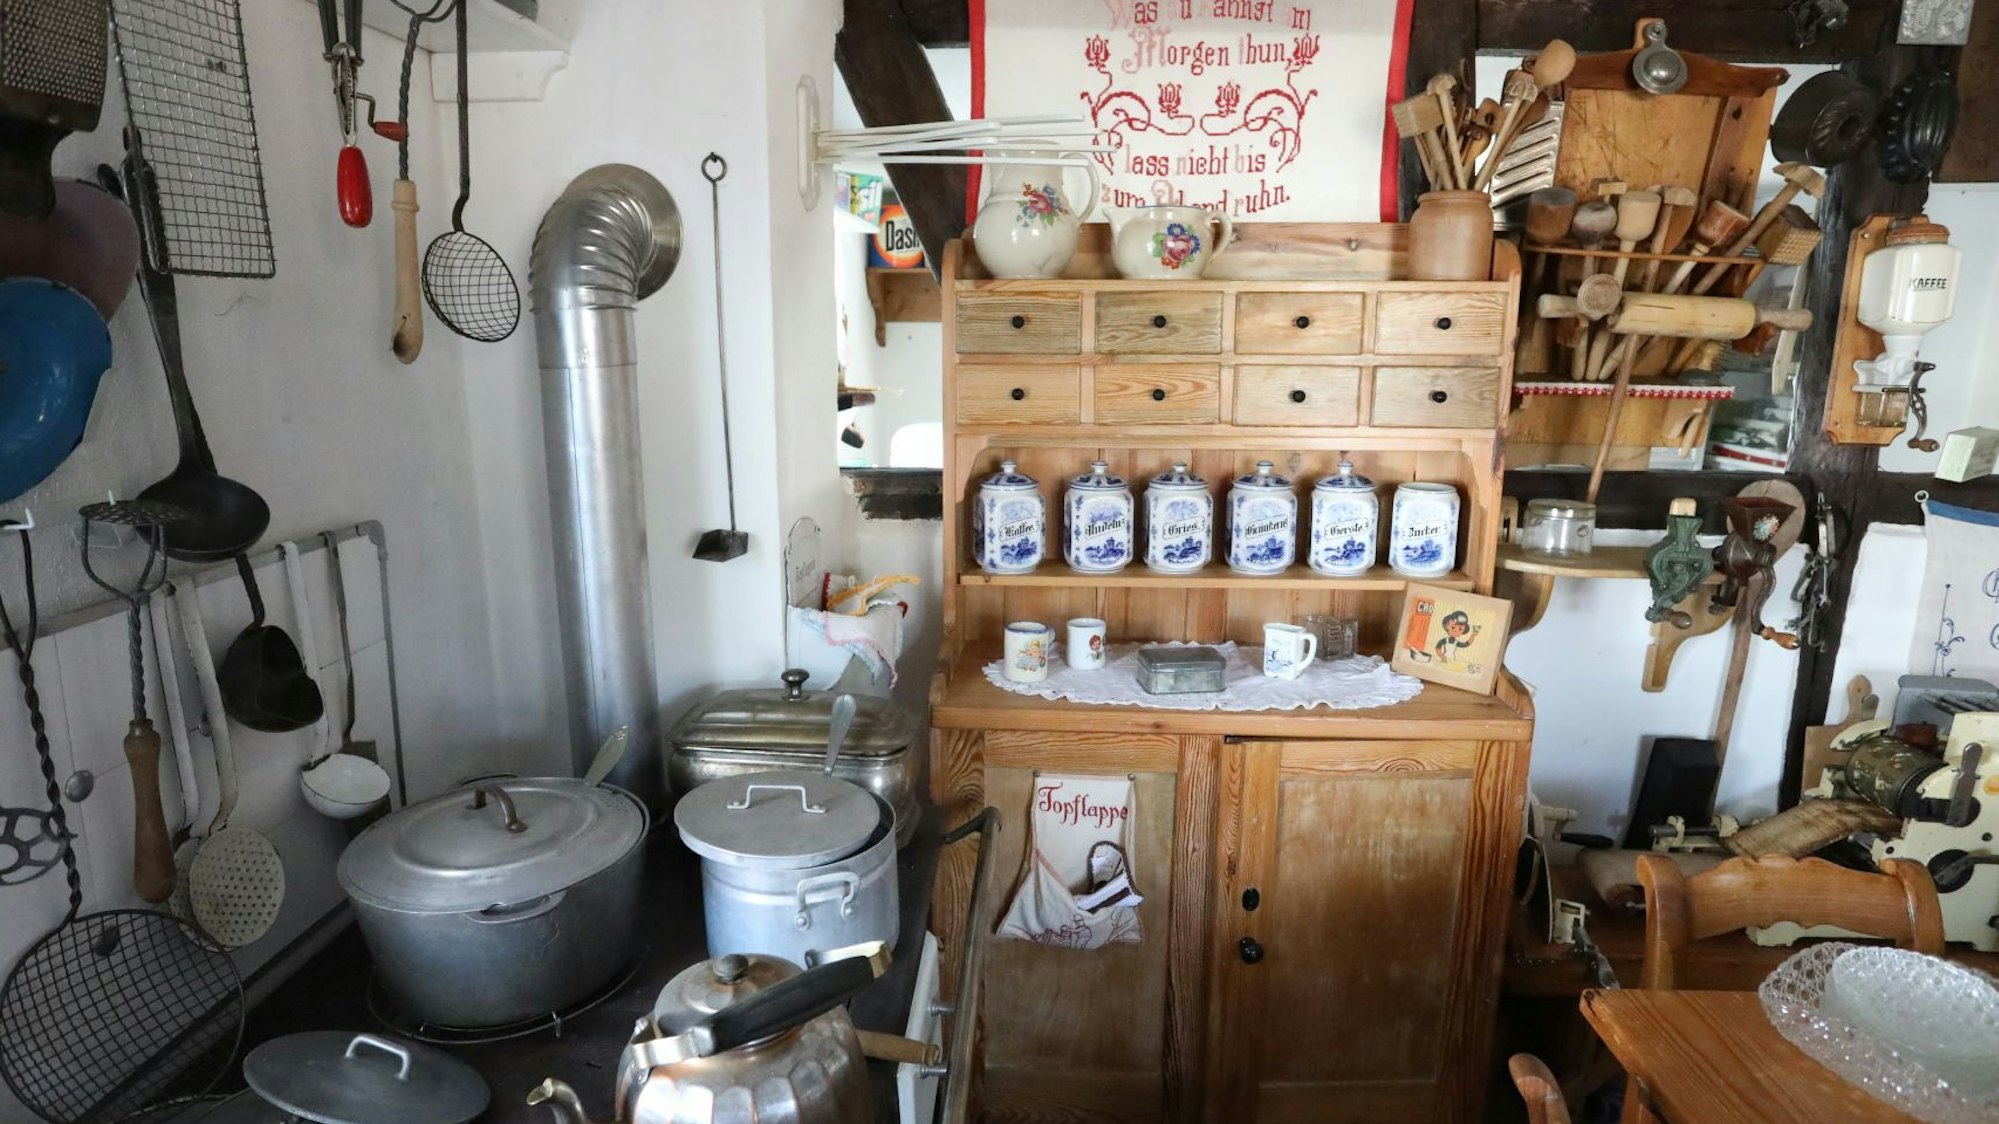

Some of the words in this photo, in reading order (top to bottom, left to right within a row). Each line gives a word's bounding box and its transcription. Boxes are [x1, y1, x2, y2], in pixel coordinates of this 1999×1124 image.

[1196, 0, 1274, 22] annst
[1121, 26, 1230, 76] Morgen
[1124, 144, 1169, 177] lass
[1234, 143, 1266, 173] bis
[1101, 183, 1146, 208] zum
[1908, 278, 1948, 290] KAFFEE
